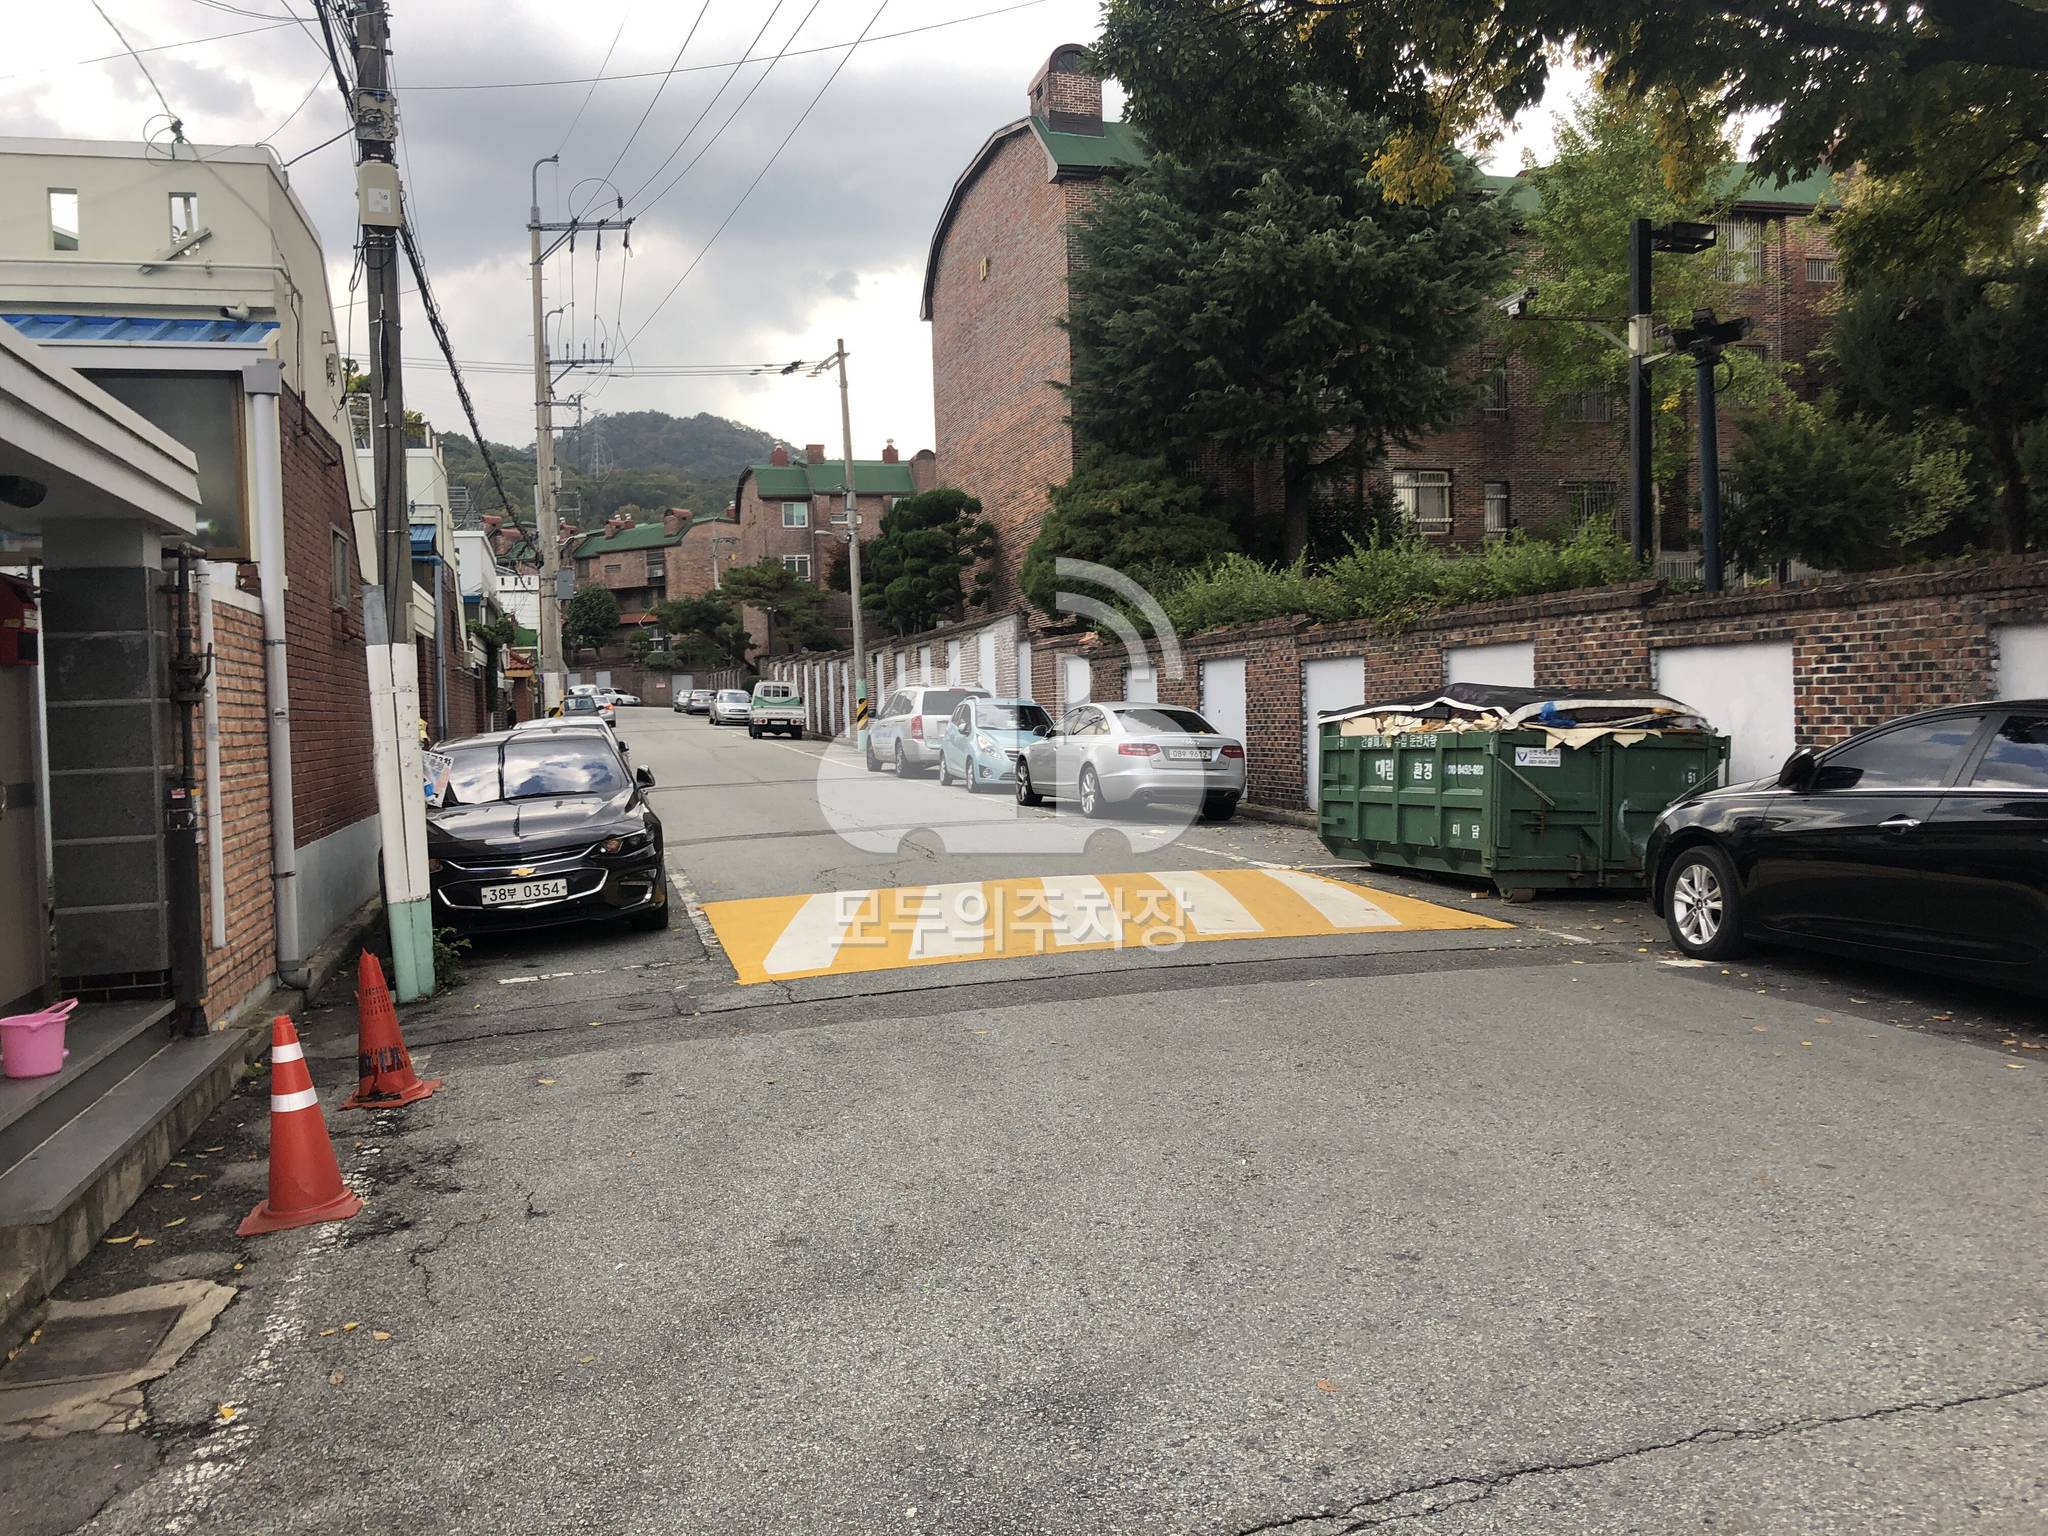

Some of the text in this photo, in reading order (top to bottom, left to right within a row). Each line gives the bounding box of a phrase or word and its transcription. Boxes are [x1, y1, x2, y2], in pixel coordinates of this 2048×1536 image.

[1409, 734, 1438, 748] 운반차량
[1413, 759, 1433, 780] 환경
[489, 882, 560, 902] 38부 0354
